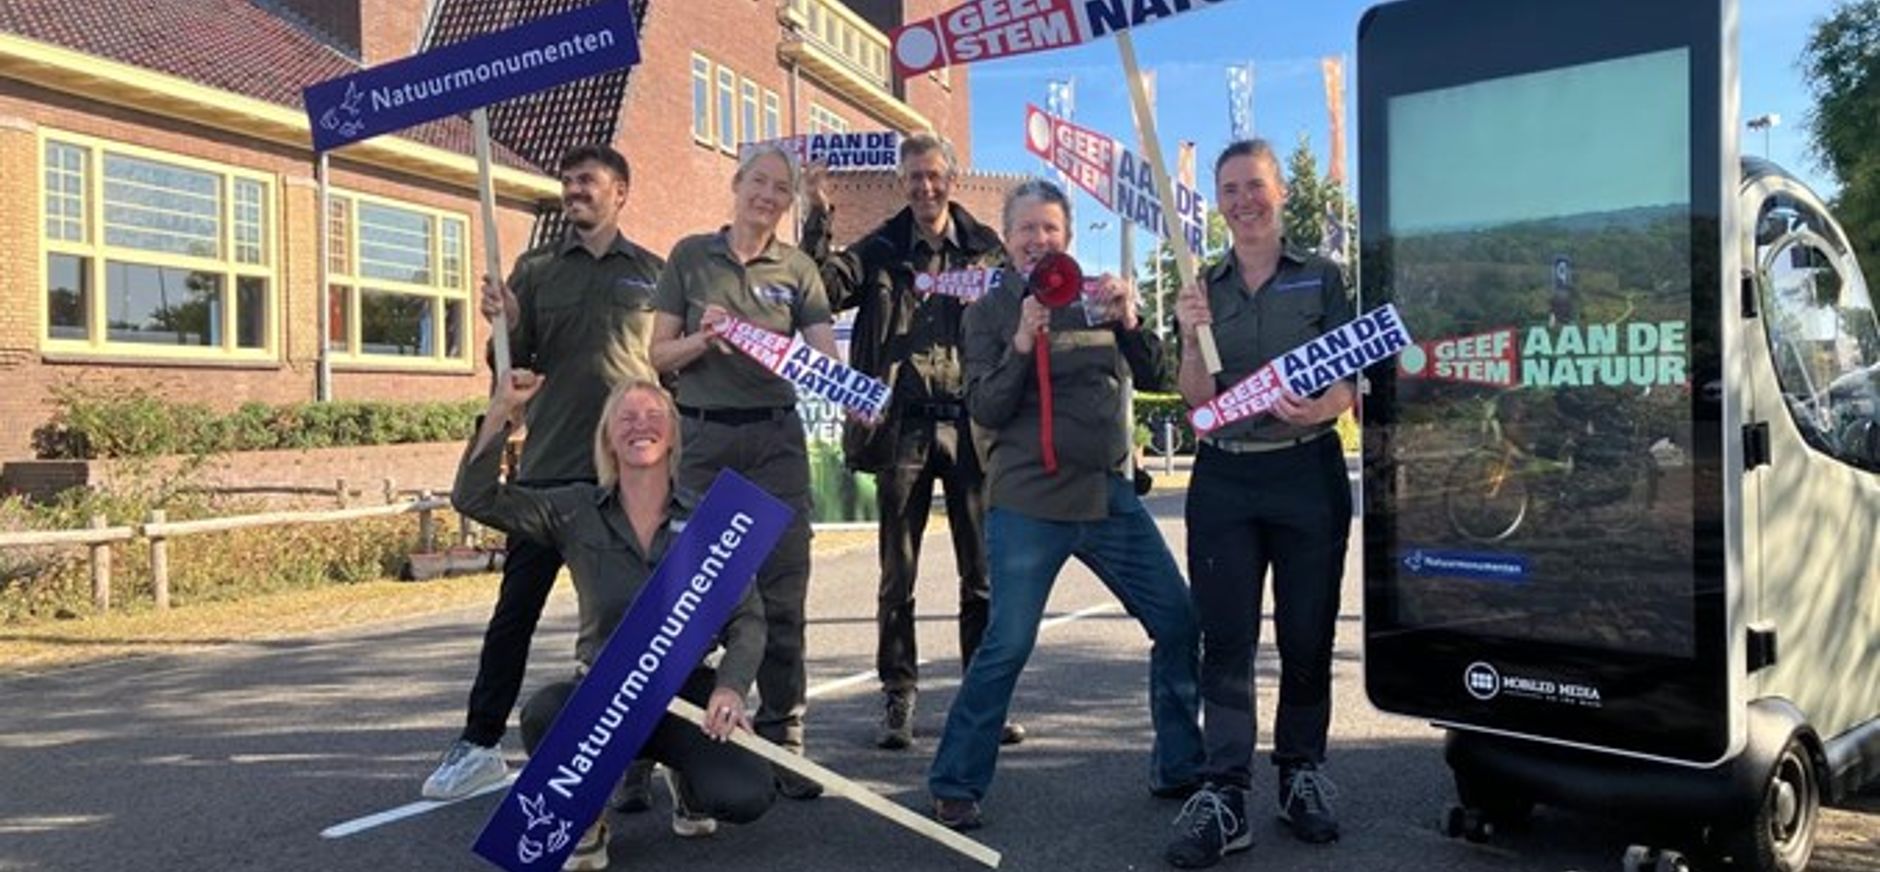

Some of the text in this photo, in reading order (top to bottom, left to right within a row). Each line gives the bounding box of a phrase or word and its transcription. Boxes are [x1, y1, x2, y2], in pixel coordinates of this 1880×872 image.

[954, 10, 1072, 60] STEM
[369, 27, 615, 112] Natuurmonumenten
[811, 134, 861, 150] AAN
[867, 132, 896, 149] DE
[1119, 150, 1203, 228] AA DE
[1283, 308, 1397, 377] AAN DE
[1288, 328, 1408, 396] NATUUR
[1434, 330, 1512, 360] GEEF
[1523, 320, 1687, 354] AAN DE
[781, 362, 876, 419] NATUUR
[792, 346, 886, 403] AAN DE
[1217, 364, 1274, 409] GEEF
[1434, 360, 1511, 384] STEM
[1522, 356, 1688, 386] NATUUR
[548, 510, 754, 798] Natuurmonumenten
[1558, 683, 1600, 700] MEDIA
